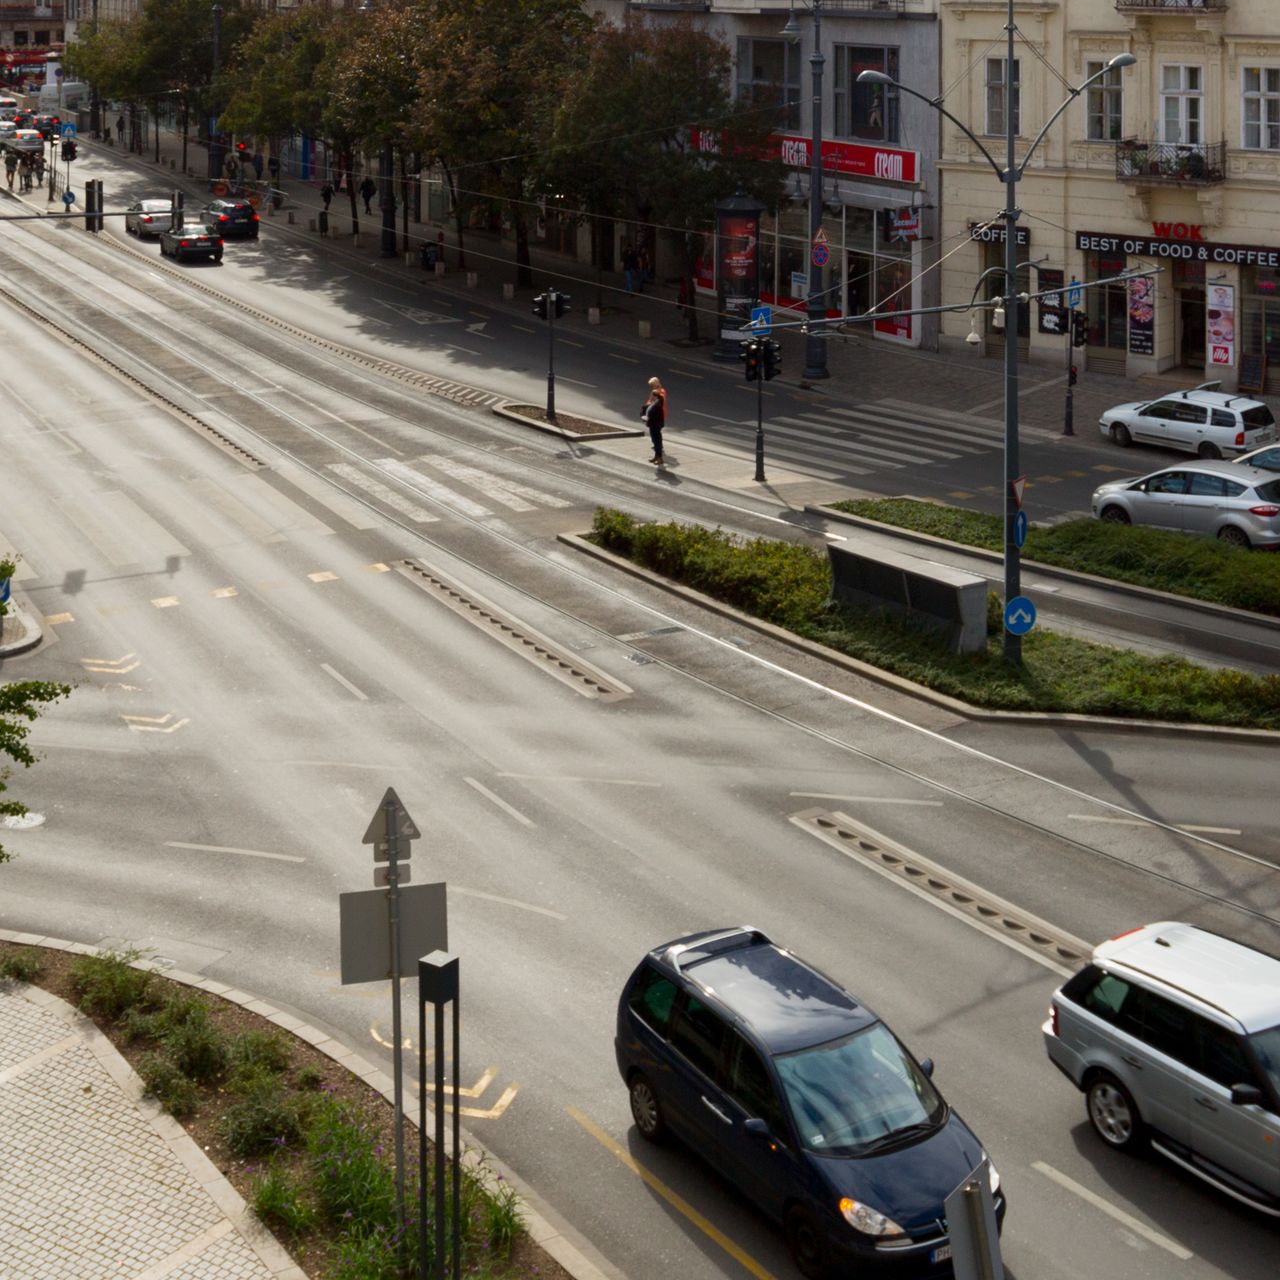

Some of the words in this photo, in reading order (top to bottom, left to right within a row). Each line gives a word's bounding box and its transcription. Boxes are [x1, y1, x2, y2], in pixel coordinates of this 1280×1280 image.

[874, 151, 903, 181] cream
[971, 228, 1027, 245] COFFE
[1152, 222, 1204, 241] WOK
[1080, 236, 1119, 252] BEST
[1123, 240, 1145, 254] OF
[1150, 243, 1193, 258] FOOD
[1197, 247, 1209, 261] &
[1213, 248, 1280, 267] COFFEE
